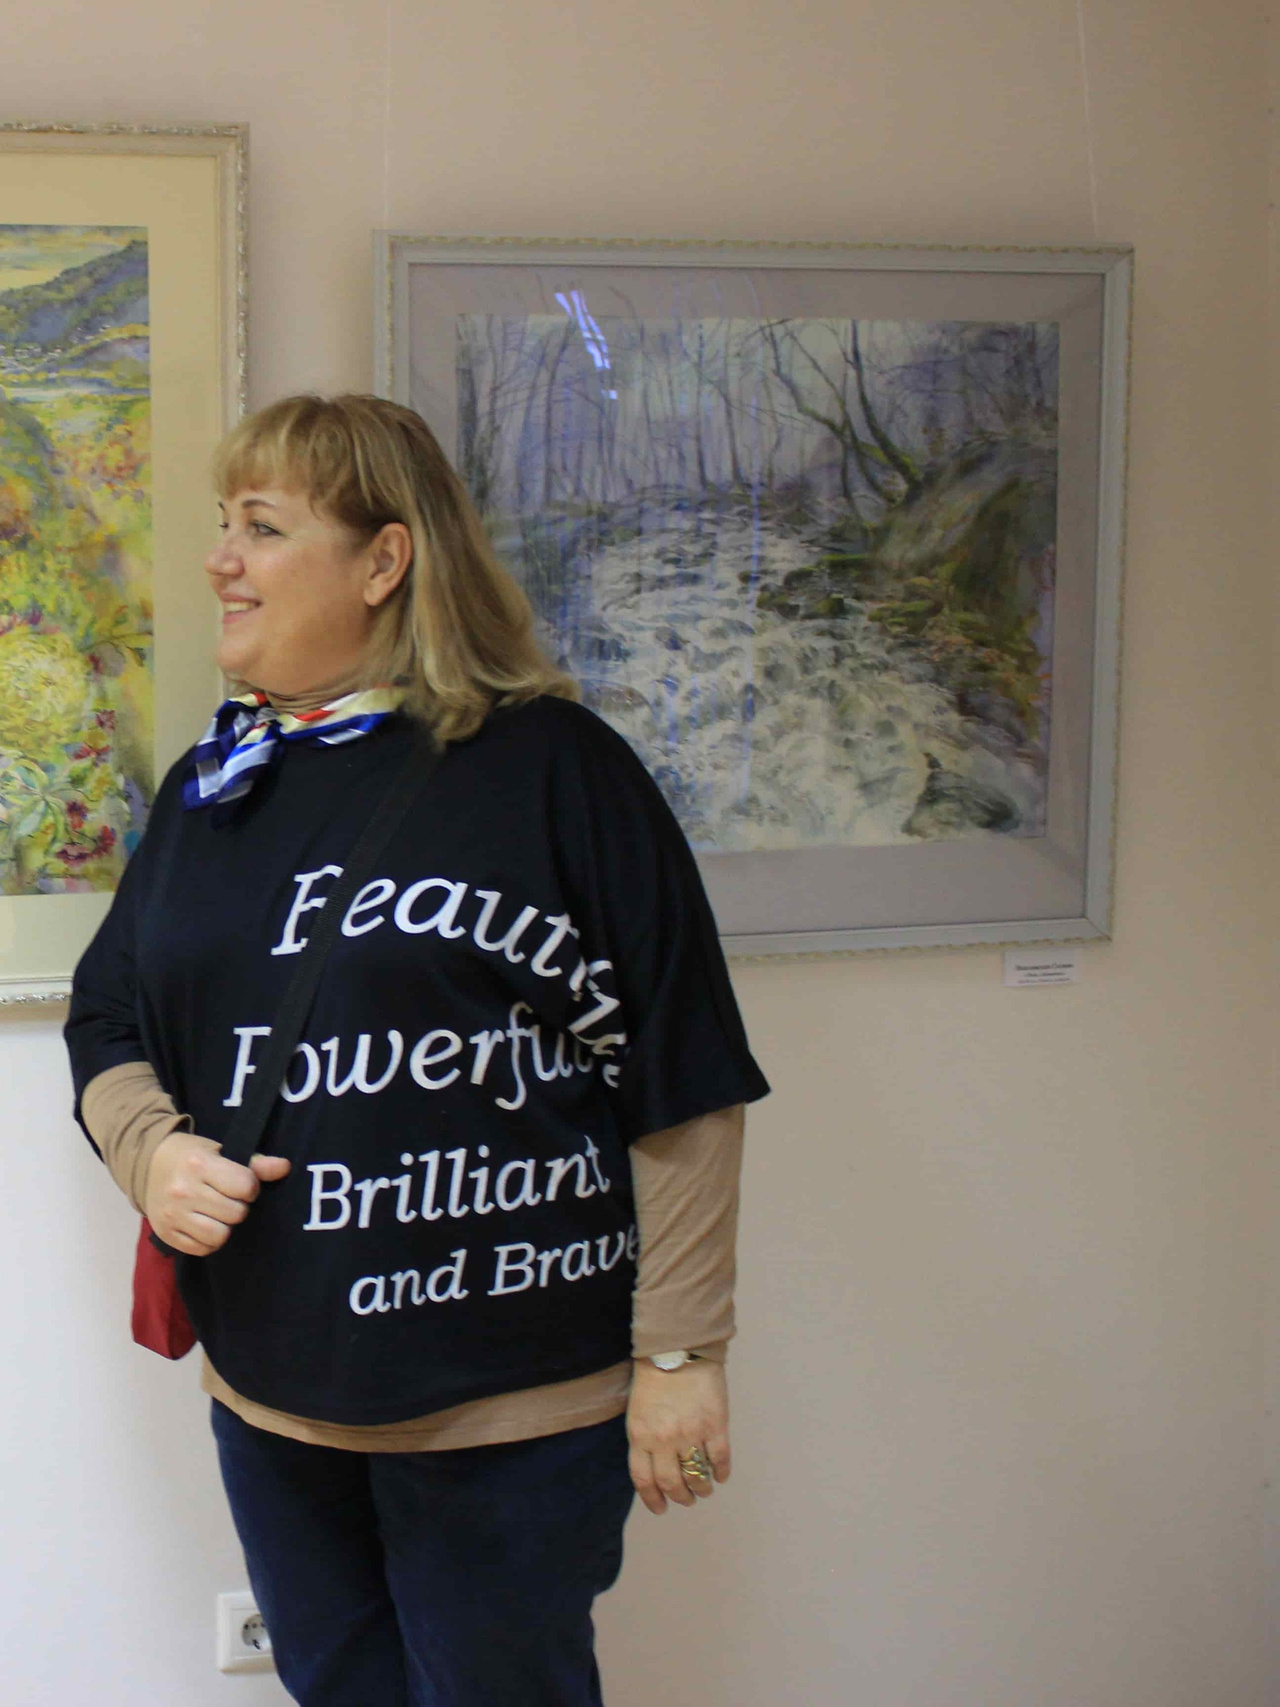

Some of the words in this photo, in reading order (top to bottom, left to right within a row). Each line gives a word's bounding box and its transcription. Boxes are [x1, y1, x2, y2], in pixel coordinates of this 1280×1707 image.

[271, 864, 620, 1036] Beaut
[303, 1135, 610, 1231] Brilliant
[349, 1248, 469, 1315] and
[487, 1223, 639, 1296] Brave
